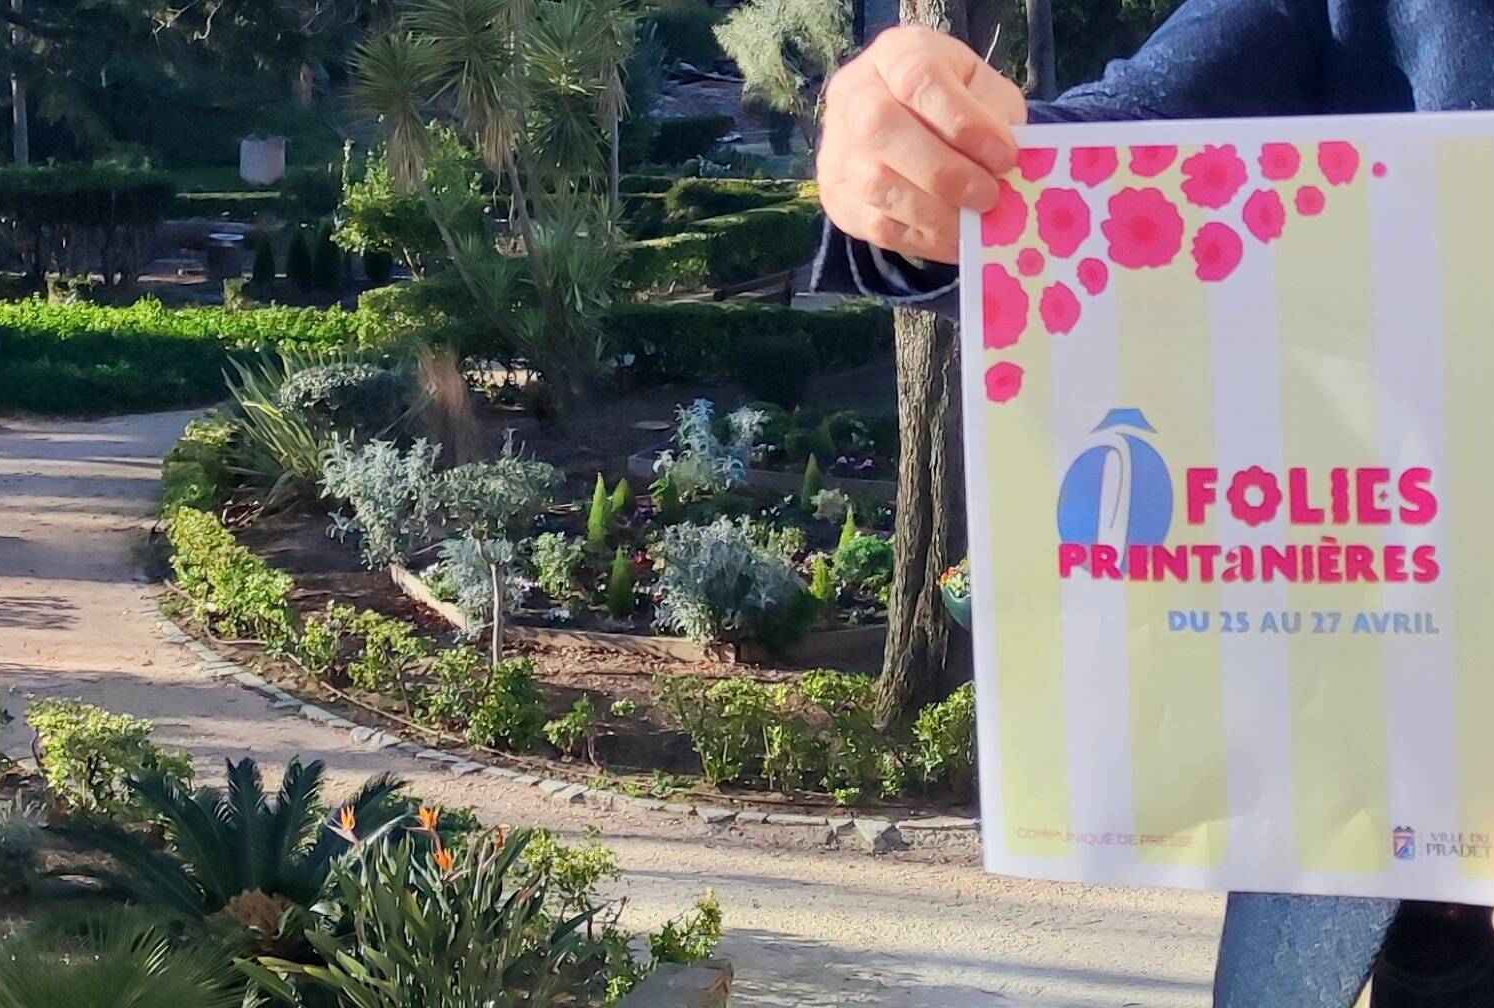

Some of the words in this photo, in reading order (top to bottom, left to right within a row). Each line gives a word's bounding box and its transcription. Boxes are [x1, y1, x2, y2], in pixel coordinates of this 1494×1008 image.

[1186, 465, 1438, 527] FOLIES
[1168, 609, 1209, 633] DU
[1218, 610, 1250, 633] 25
[1259, 611, 1302, 634] AU
[1311, 611, 1342, 634] 27
[1351, 612, 1440, 634] AVRIL
[1116, 833, 1138, 846] DE
[1425, 843, 1493, 859] PRADET
